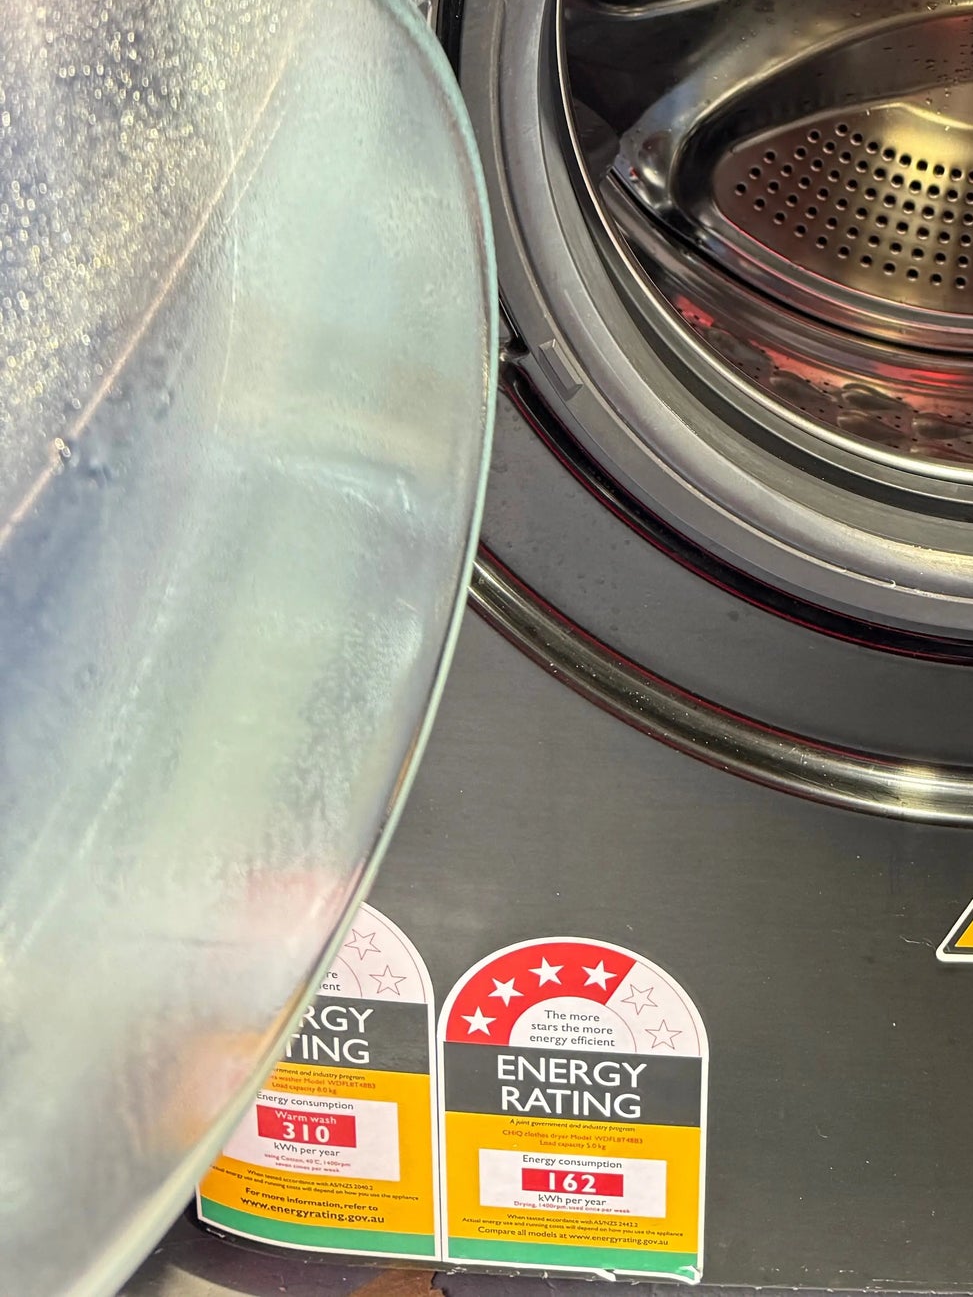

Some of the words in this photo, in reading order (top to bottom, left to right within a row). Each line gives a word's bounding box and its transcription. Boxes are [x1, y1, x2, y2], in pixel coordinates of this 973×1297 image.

[299, 1005, 374, 1033] RGY
[544, 1010, 567, 1020] The
[569, 1014, 600, 1022] more
[531, 1023, 558, 1031] stars
[561, 1023, 579, 1033] the
[582, 1027, 613, 1035] more
[284, 1033, 370, 1063] TING
[529, 1035, 568, 1046] energy
[570, 1037, 615, 1047] efficient
[497, 1054, 647, 1088] ENERGY
[256, 1091, 288, 1105] Energy
[291, 1097, 354, 1110] consumption
[501, 1085, 641, 1119] RATING
[275, 1110, 308, 1124] Warm
[311, 1115, 337, 1125] wash
[531, 1121, 568, 1129] government
[582, 1123, 608, 1132] industry
[608, 1125, 636, 1133] program
[282, 1121, 330, 1143] 310
[273, 1142, 298, 1153] kWh
[300, 1147, 318, 1157] per
[319, 1148, 340, 1158] year
[522, 1154, 556, 1167] Energy
[558, 1158, 622, 1170] consumption
[548, 1172, 597, 1193] 162
[245, 1187, 260, 1196] For
[261, 1192, 285, 1202] more
[286, 1196, 343, 1209] information,
[344, 1202, 367, 1211] refer
[538, 1194, 563, 1204] kWh
[565, 1197, 582, 1206] per
[584, 1198, 606, 1206] year
[240, 1196, 385, 1223] www.energyrating.gov.au
[477, 1226, 516, 1236] Compare
[528, 1230, 557, 1239] models
[568, 1233, 669, 1246] www.energyrating.gov.au
